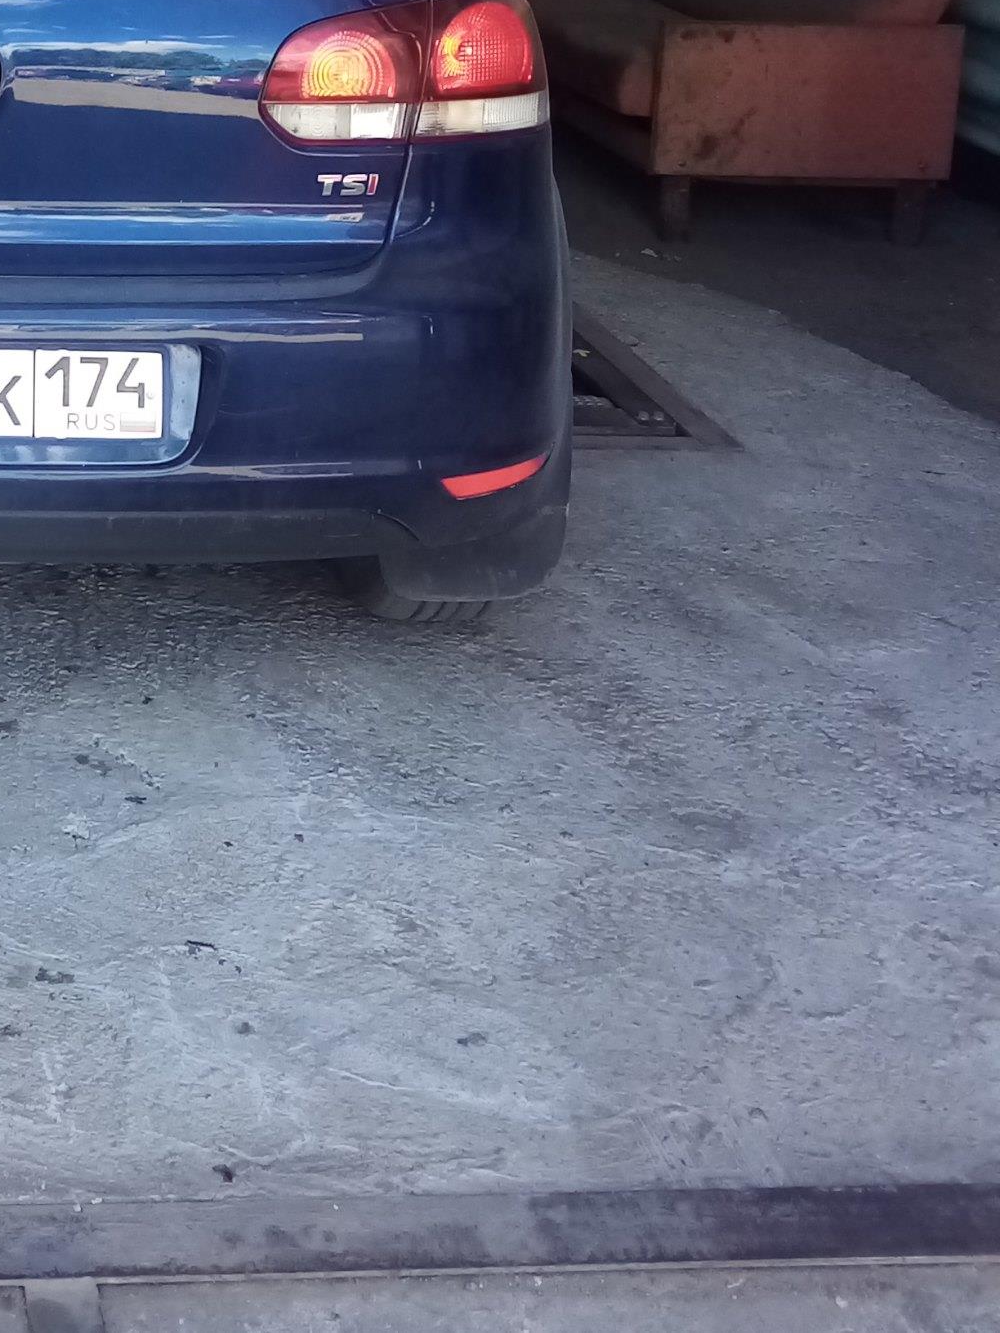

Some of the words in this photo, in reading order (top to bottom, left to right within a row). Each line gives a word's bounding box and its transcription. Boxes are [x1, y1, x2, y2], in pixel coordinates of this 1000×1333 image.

[317, 173, 379, 196] TSI
[44, 356, 146, 409] 174
[66, 413, 116, 431] RUS
